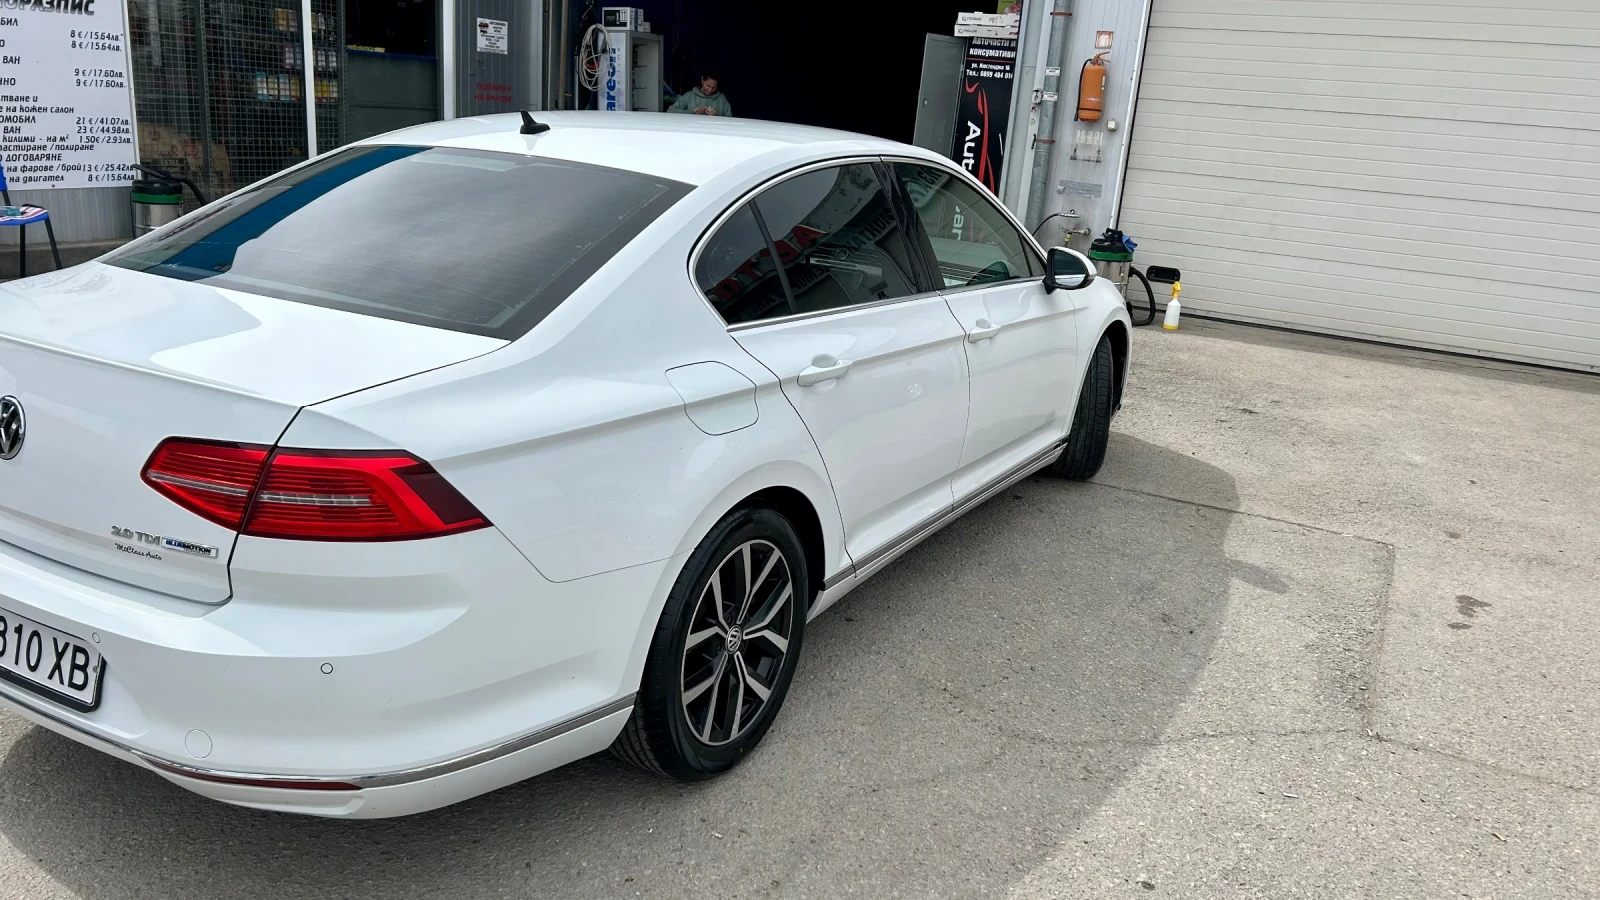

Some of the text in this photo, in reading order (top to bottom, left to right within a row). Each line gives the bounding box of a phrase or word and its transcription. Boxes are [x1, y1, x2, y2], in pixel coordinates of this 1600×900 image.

[0, 0, 95, 15] ОРАЗПИС
[0, 17, 18, 26] БИЛ
[70, 30, 75, 38] 8
[972, 36, 1009, 47] Авточасти
[969, 48, 1016, 58] консумативи
[2, 56, 20, 64] ВАН
[19, 105, 47, 113] кожен
[0, 115, 36, 123] ОМОБИЛ
[76, 117, 85, 125] 21
[3, 126, 21, 134] ВАН
[2, 135, 35, 143] килими
[0, 144, 47, 152] астиране
[961, 120, 981, 171] Aut
[5, 153, 62, 162] ДОГОВАРЯНЕ
[20, 164, 54, 173] фарове
[22, 175, 65, 184] двигател
[135, 530, 161, 546] TDI
[145, 551, 162, 560] Auto
[47, 636, 90, 692] XB
